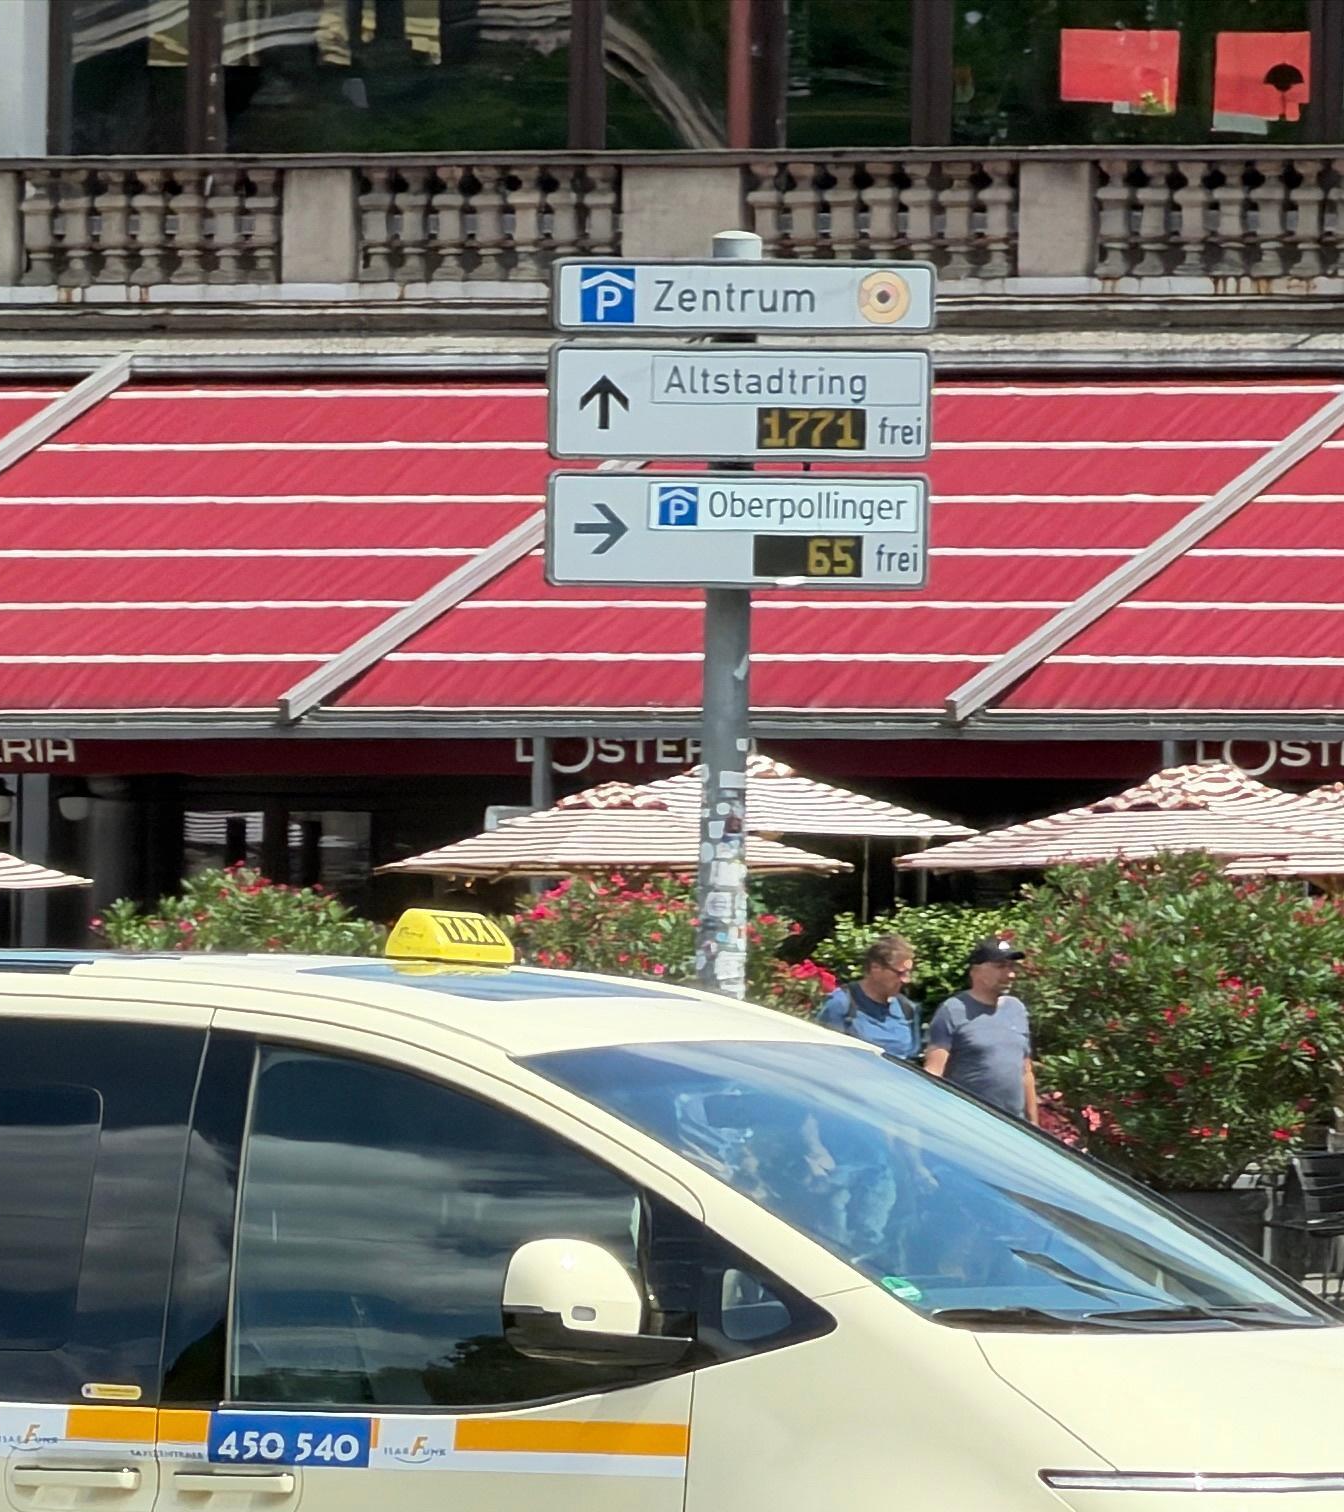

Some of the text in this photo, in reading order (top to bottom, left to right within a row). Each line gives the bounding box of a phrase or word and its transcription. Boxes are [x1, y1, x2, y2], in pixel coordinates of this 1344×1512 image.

[654, 280, 816, 313] Zentrum
[664, 365, 867, 402] Altstadtring
[762, 410, 923, 448] 1771 frei
[708, 490, 908, 529] Oberpollinger
[806, 539, 919, 575] 65 frei
[435, 916, 505, 945] TAXI
[217, 1430, 360, 1462] 450 540
